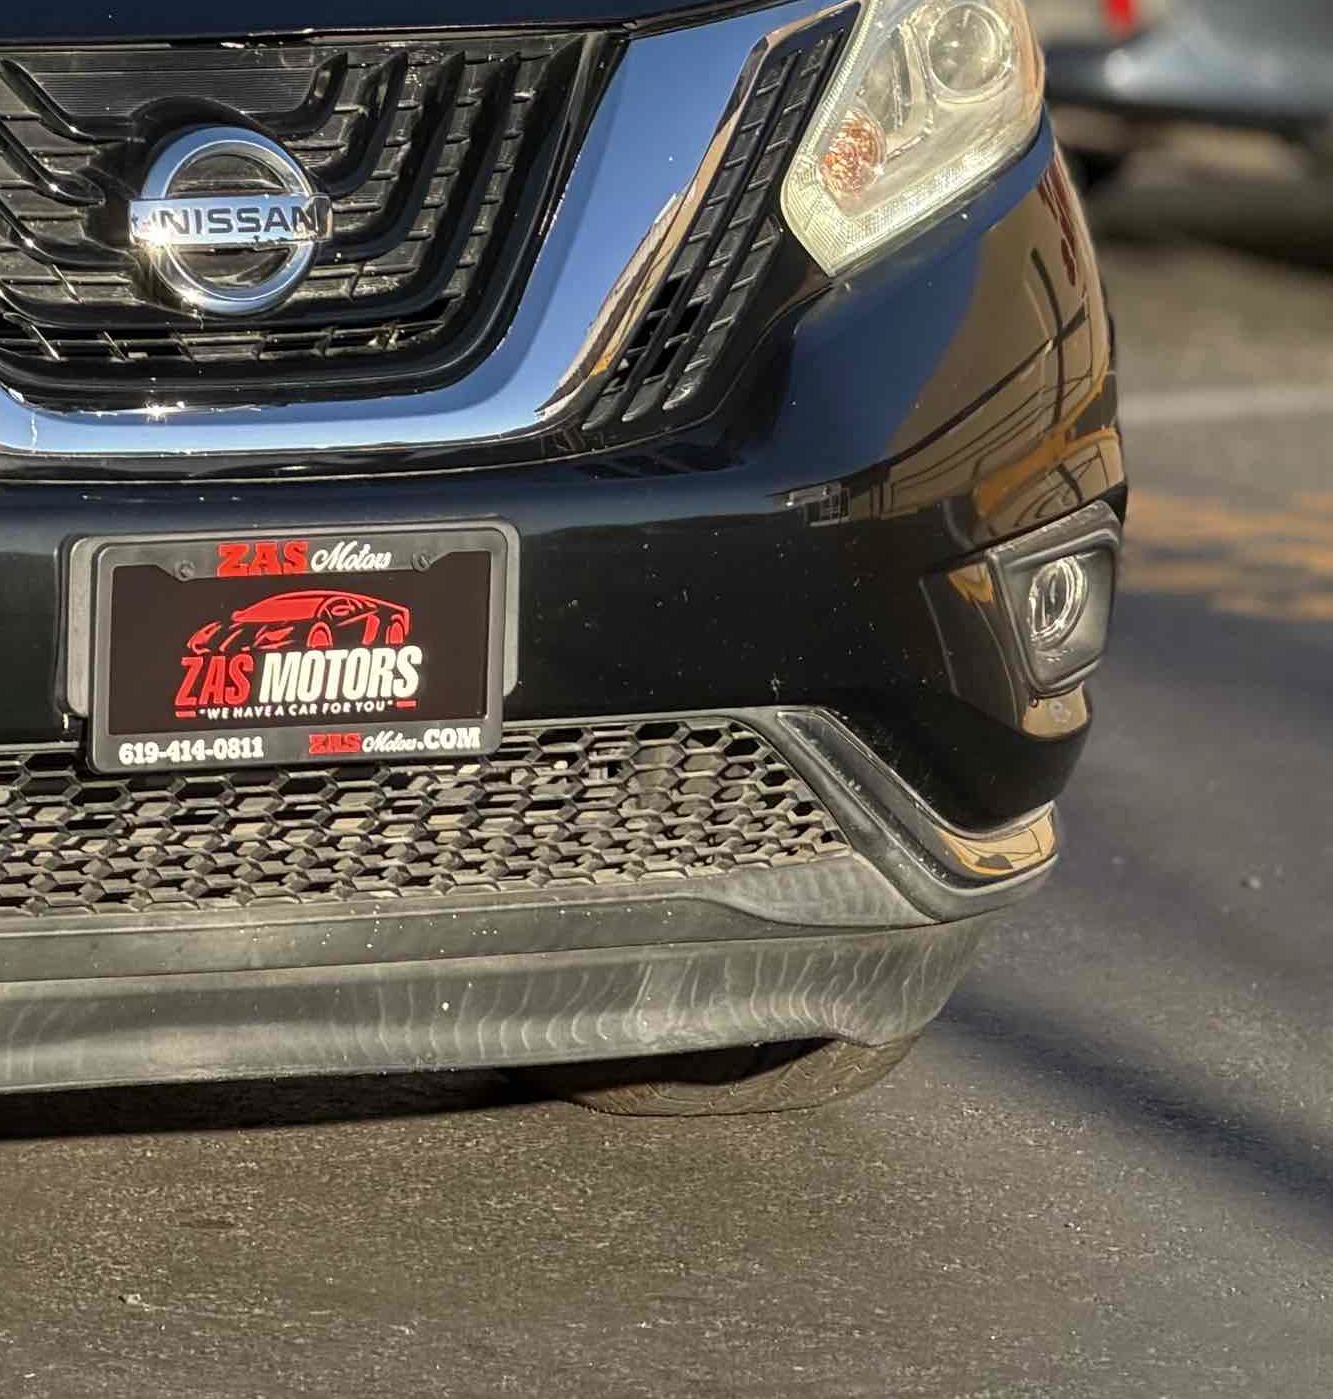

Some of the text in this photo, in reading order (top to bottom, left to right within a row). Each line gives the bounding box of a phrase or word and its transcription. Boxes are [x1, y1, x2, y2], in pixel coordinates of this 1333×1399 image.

[158, 205, 318, 236] NISSAN
[216, 540, 392, 578] ZAS Motors
[174, 645, 423, 706] ZAS MOTORS
[233, 704, 272, 719] HAVE
[274, 704, 285, 717] A
[288, 703, 317, 716] CAR
[322, 701, 351, 715] FOR
[118, 736, 264, 765] 619-414-0811
